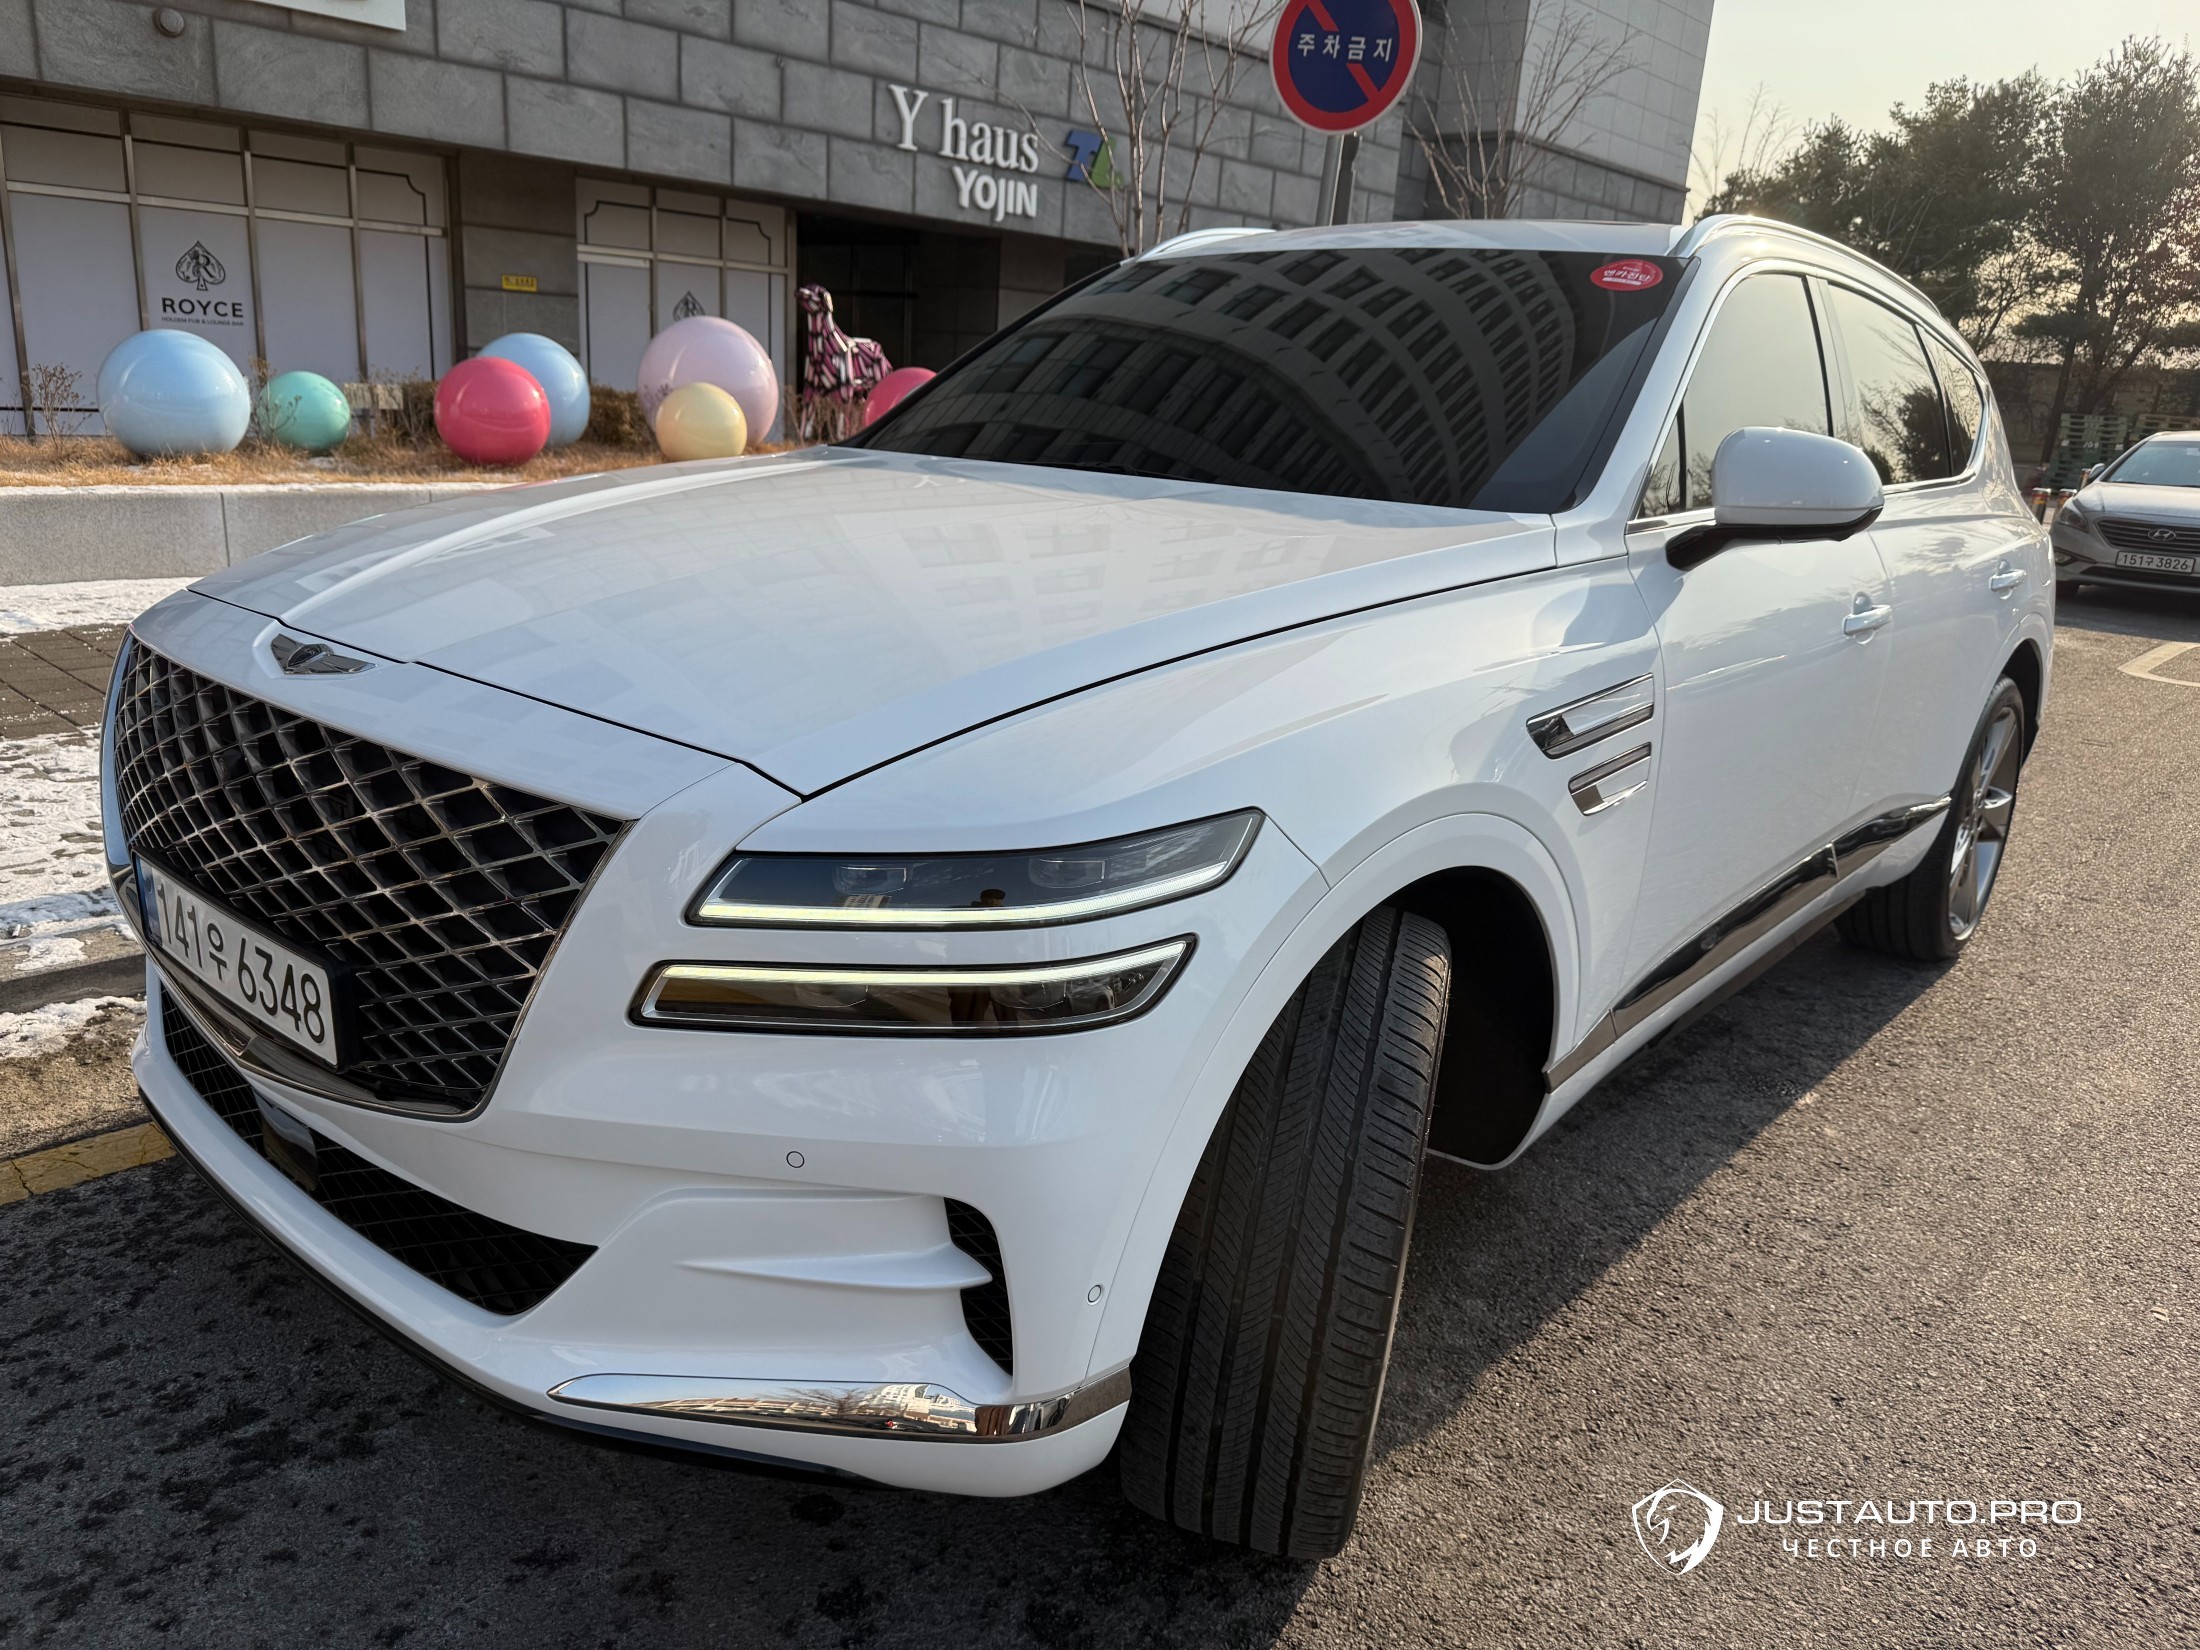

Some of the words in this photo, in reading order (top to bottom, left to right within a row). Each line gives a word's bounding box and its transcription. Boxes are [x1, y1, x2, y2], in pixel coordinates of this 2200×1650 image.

[1297, 33, 1393, 62] 주차금지
[888, 83, 929, 151] Y
[938, 97, 1040, 173] haus
[952, 165, 1038, 223] YOJIN
[161, 297, 244, 319] ROYCE
